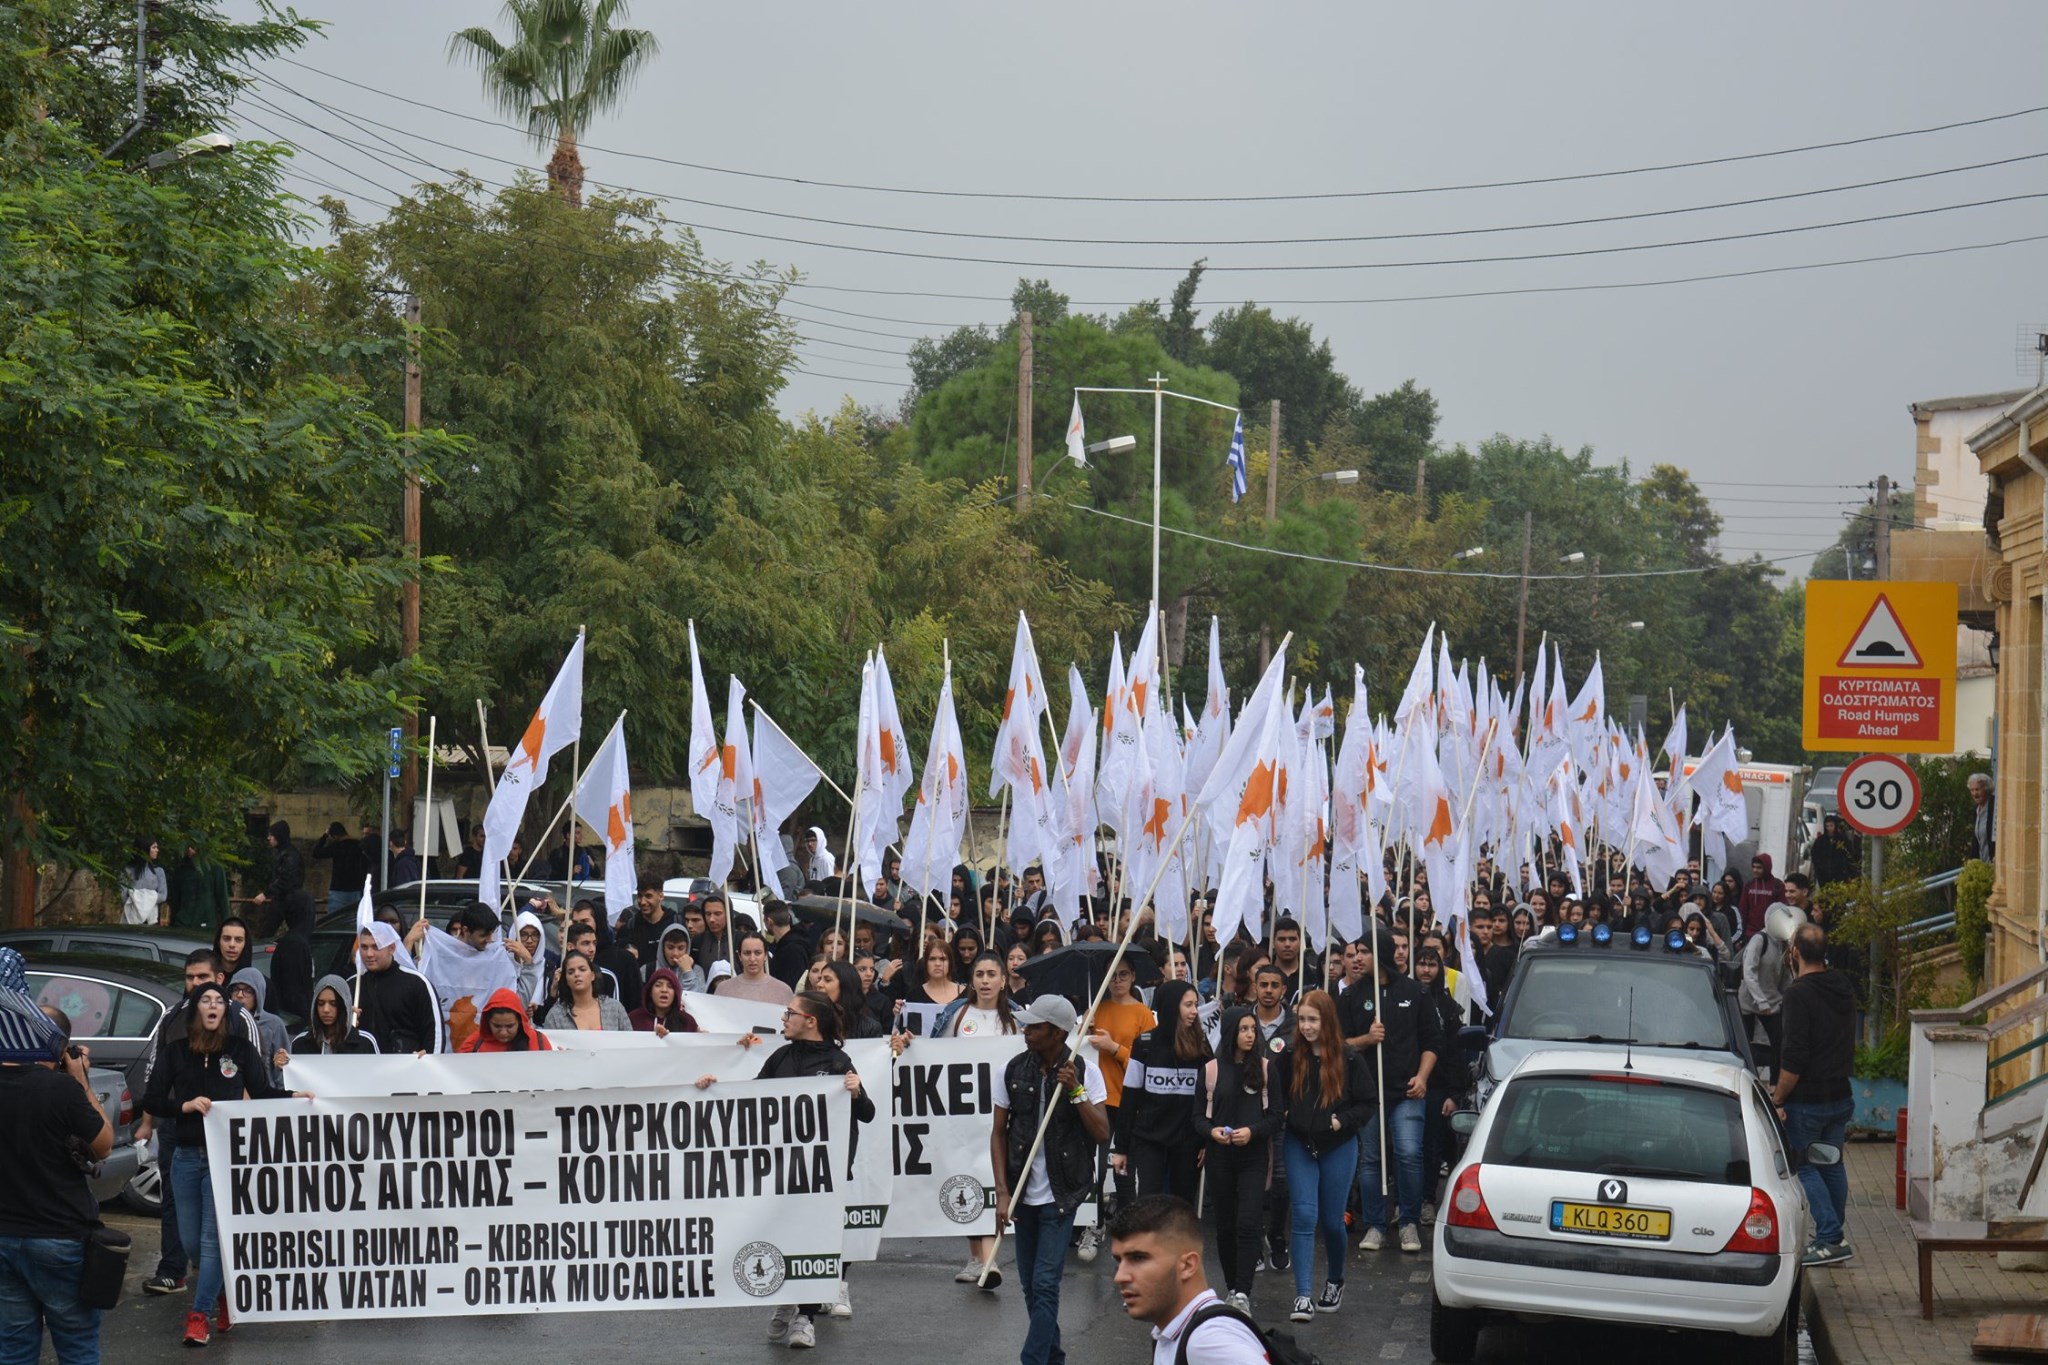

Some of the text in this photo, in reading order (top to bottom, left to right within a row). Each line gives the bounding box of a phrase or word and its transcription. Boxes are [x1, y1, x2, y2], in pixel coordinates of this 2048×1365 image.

[1838, 680, 1921, 692] ΚΥΡΤΩΜΑΤΑ
[1823, 693, 1935, 708] ΟΔΟΣΤΡΩΜΑΤΟΣ
[1838, 709, 1920, 724] Road Humps
[1858, 724, 1899, 736] Ahead
[1854, 779, 1902, 810] 30
[1147, 1074, 1196, 1087] TOKYO
[230, 1108, 515, 1165] ΕΛΛΗΝΟΚΥΠΡΙΟΙ
[554, 1094, 829, 1154] ΤΟΥΡΚΟΚΥΠΡΙΟΙ
[230, 1163, 366, 1216] ΚΟΙΝΟΣ
[377, 1159, 513, 1211] ΑΓΩΝΑΣ
[558, 1152, 670, 1205] ΚΟΙΝΗ
[683, 1145, 833, 1200] ΠΑΤΡΙΔΑ
[1574, 1208, 1649, 1232] KLQ 360
[232, 1229, 346, 1271] KIBRISLI
[352, 1227, 459, 1267] RUMLAR
[488, 1221, 598, 1262] KIBRISLI
[604, 1217, 714, 1258] TURKLER
[235, 1272, 329, 1313] ORTAK
[338, 1269, 427, 1309] VATAN
[464, 1265, 556, 1306] ORTAK
[567, 1259, 715, 1302] MUCADELE
